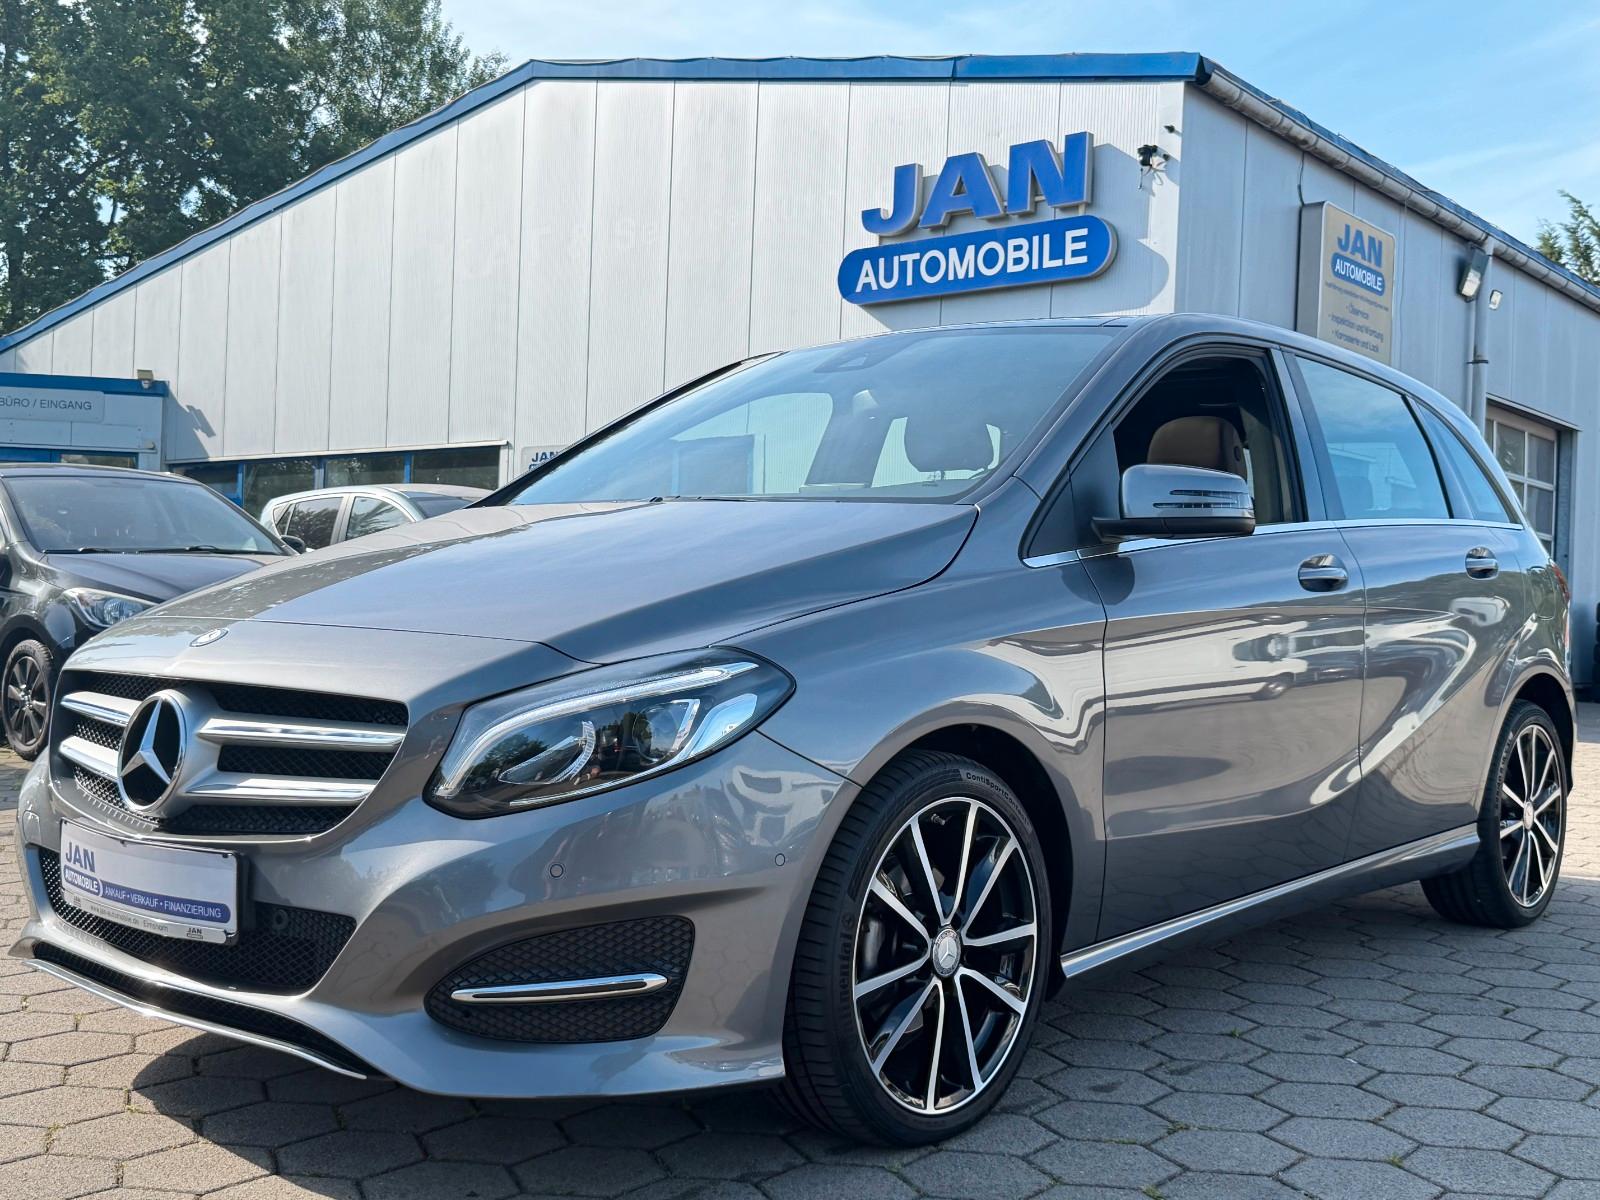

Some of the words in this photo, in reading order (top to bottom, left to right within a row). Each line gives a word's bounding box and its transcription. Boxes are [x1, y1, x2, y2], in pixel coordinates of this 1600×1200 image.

[861, 131, 1093, 236] JAN
[855, 228, 1088, 293] AUTOMOBILE
[1337, 224, 1382, 268] JAN
[1334, 258, 1382, 291] AUTOMOBILE
[0, 395, 30, 408] BÜRO
[40, 399, 92, 410] EINGANG
[66, 841, 95, 872] JAN
[65, 869, 99, 893] AUTOMOBILE
[105, 885, 126, 900] ANKAUF
[131, 892, 159, 908] VERKAUF
[164, 900, 222, 919] FINANZIERUNG
